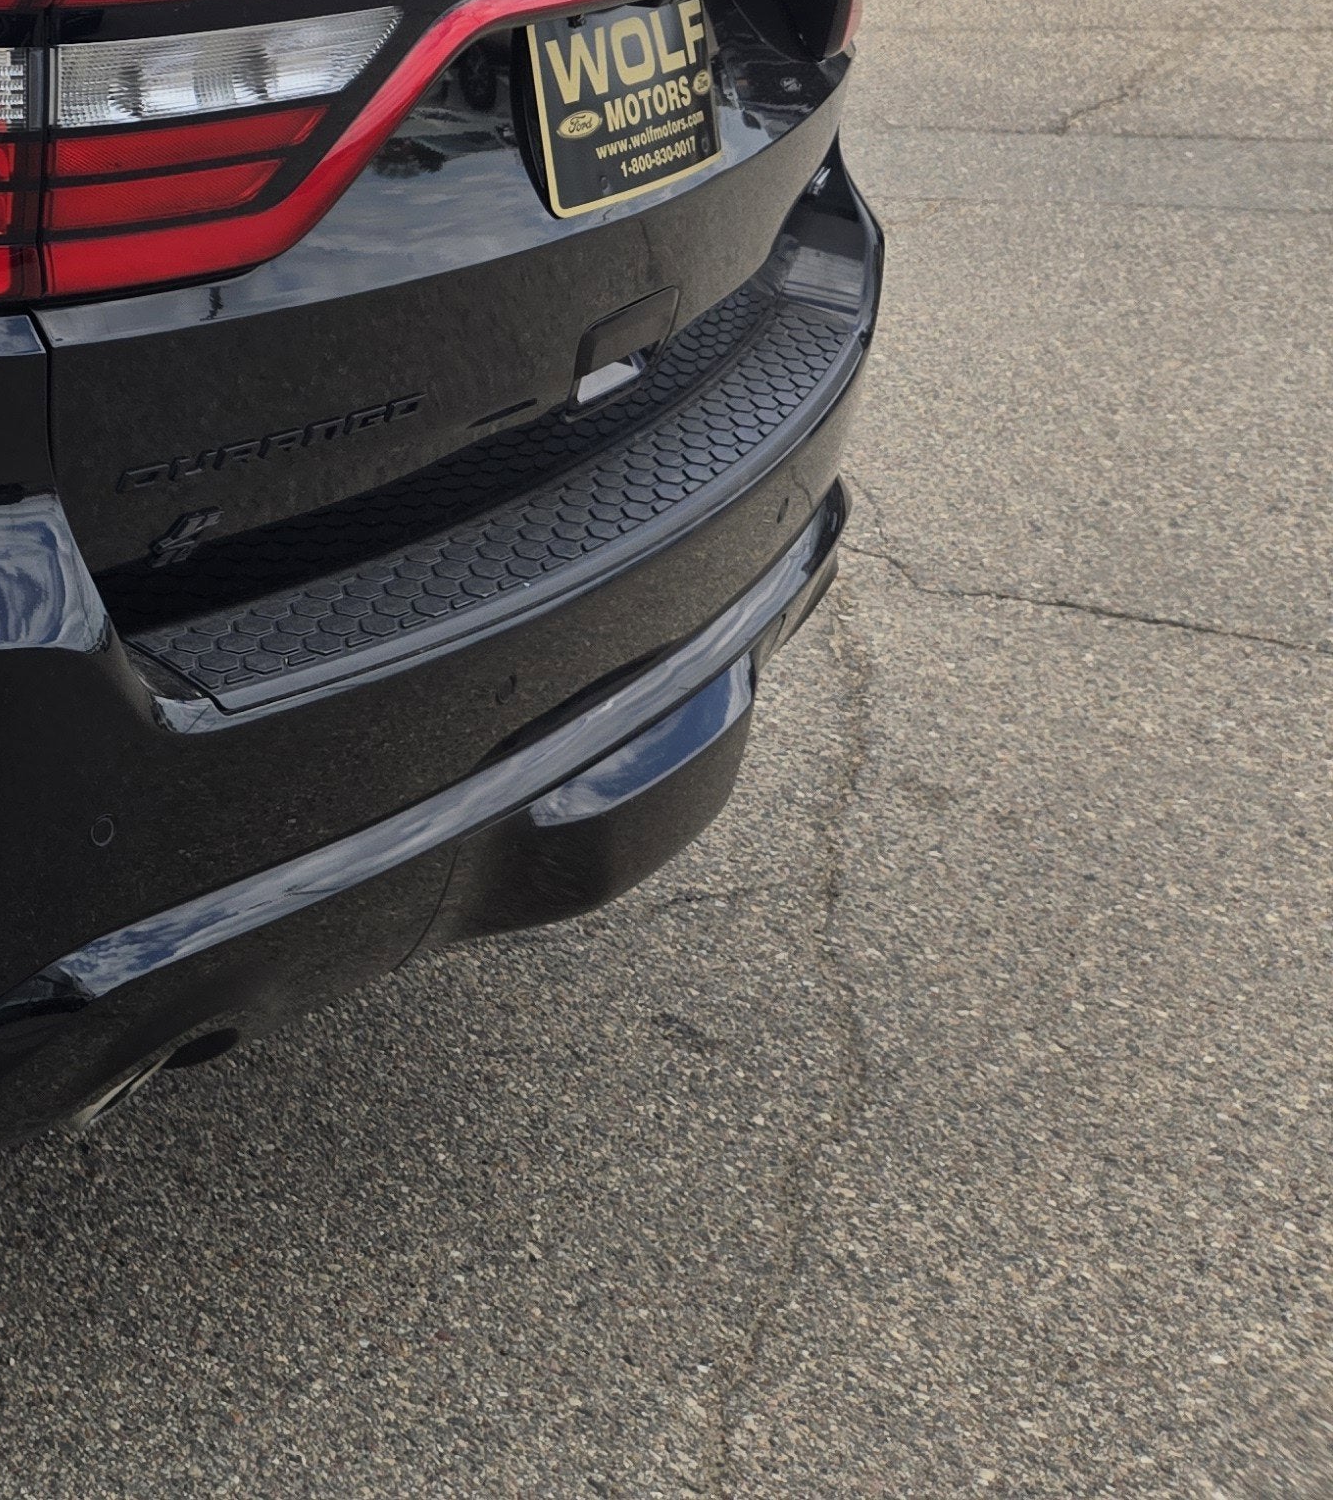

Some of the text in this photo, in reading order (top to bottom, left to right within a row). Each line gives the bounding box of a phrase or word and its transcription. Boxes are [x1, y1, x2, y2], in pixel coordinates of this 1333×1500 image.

[567, 112, 594, 134] Ford
[604, 75, 692, 133] MOTORS
[595, 110, 705, 160] www.wolfmotors.com
[620, 135, 697, 178] 1-800-830-0017
